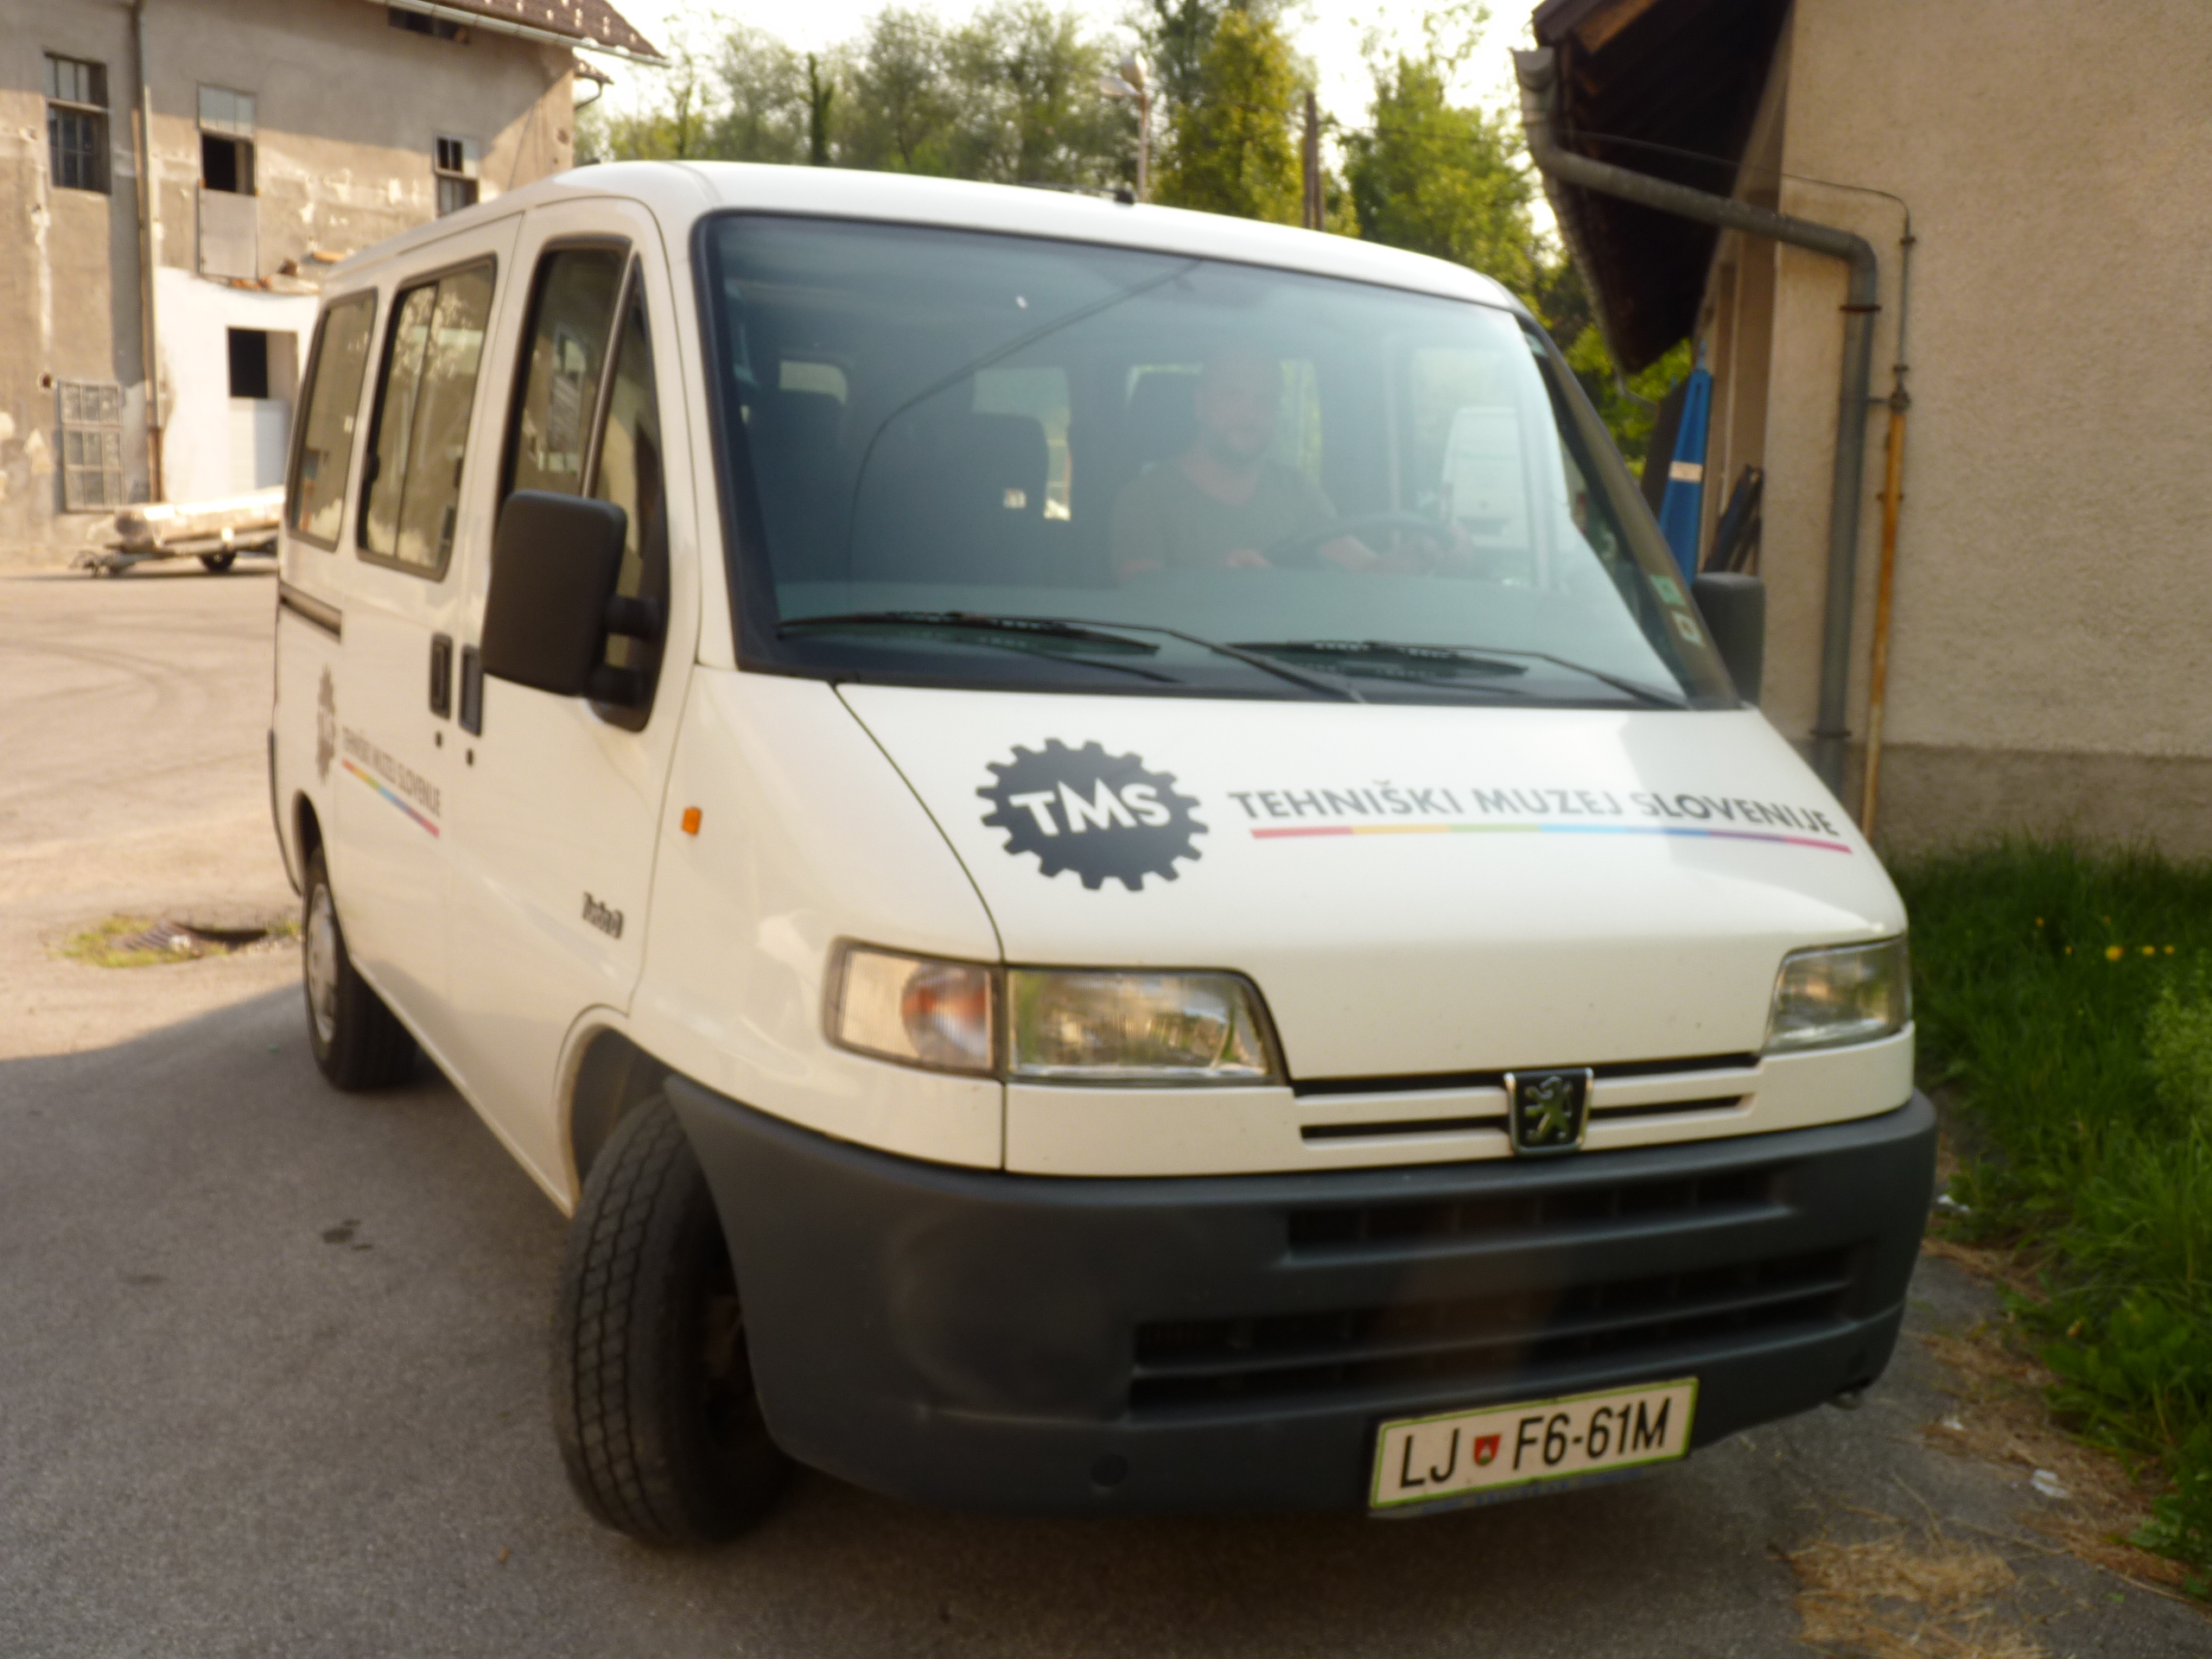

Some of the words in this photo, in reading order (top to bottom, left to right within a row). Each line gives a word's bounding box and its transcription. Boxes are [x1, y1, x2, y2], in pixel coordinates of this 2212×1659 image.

[1007, 777, 1172, 837] TMS
[1226, 779, 1465, 820] TEHNIŠKI
[1471, 787, 1624, 816] MUZEJ
[1630, 791, 1840, 837] SLOVENIJE
[1400, 1427, 1460, 1489] LJ
[1512, 1396, 1672, 1471] F6-61M
